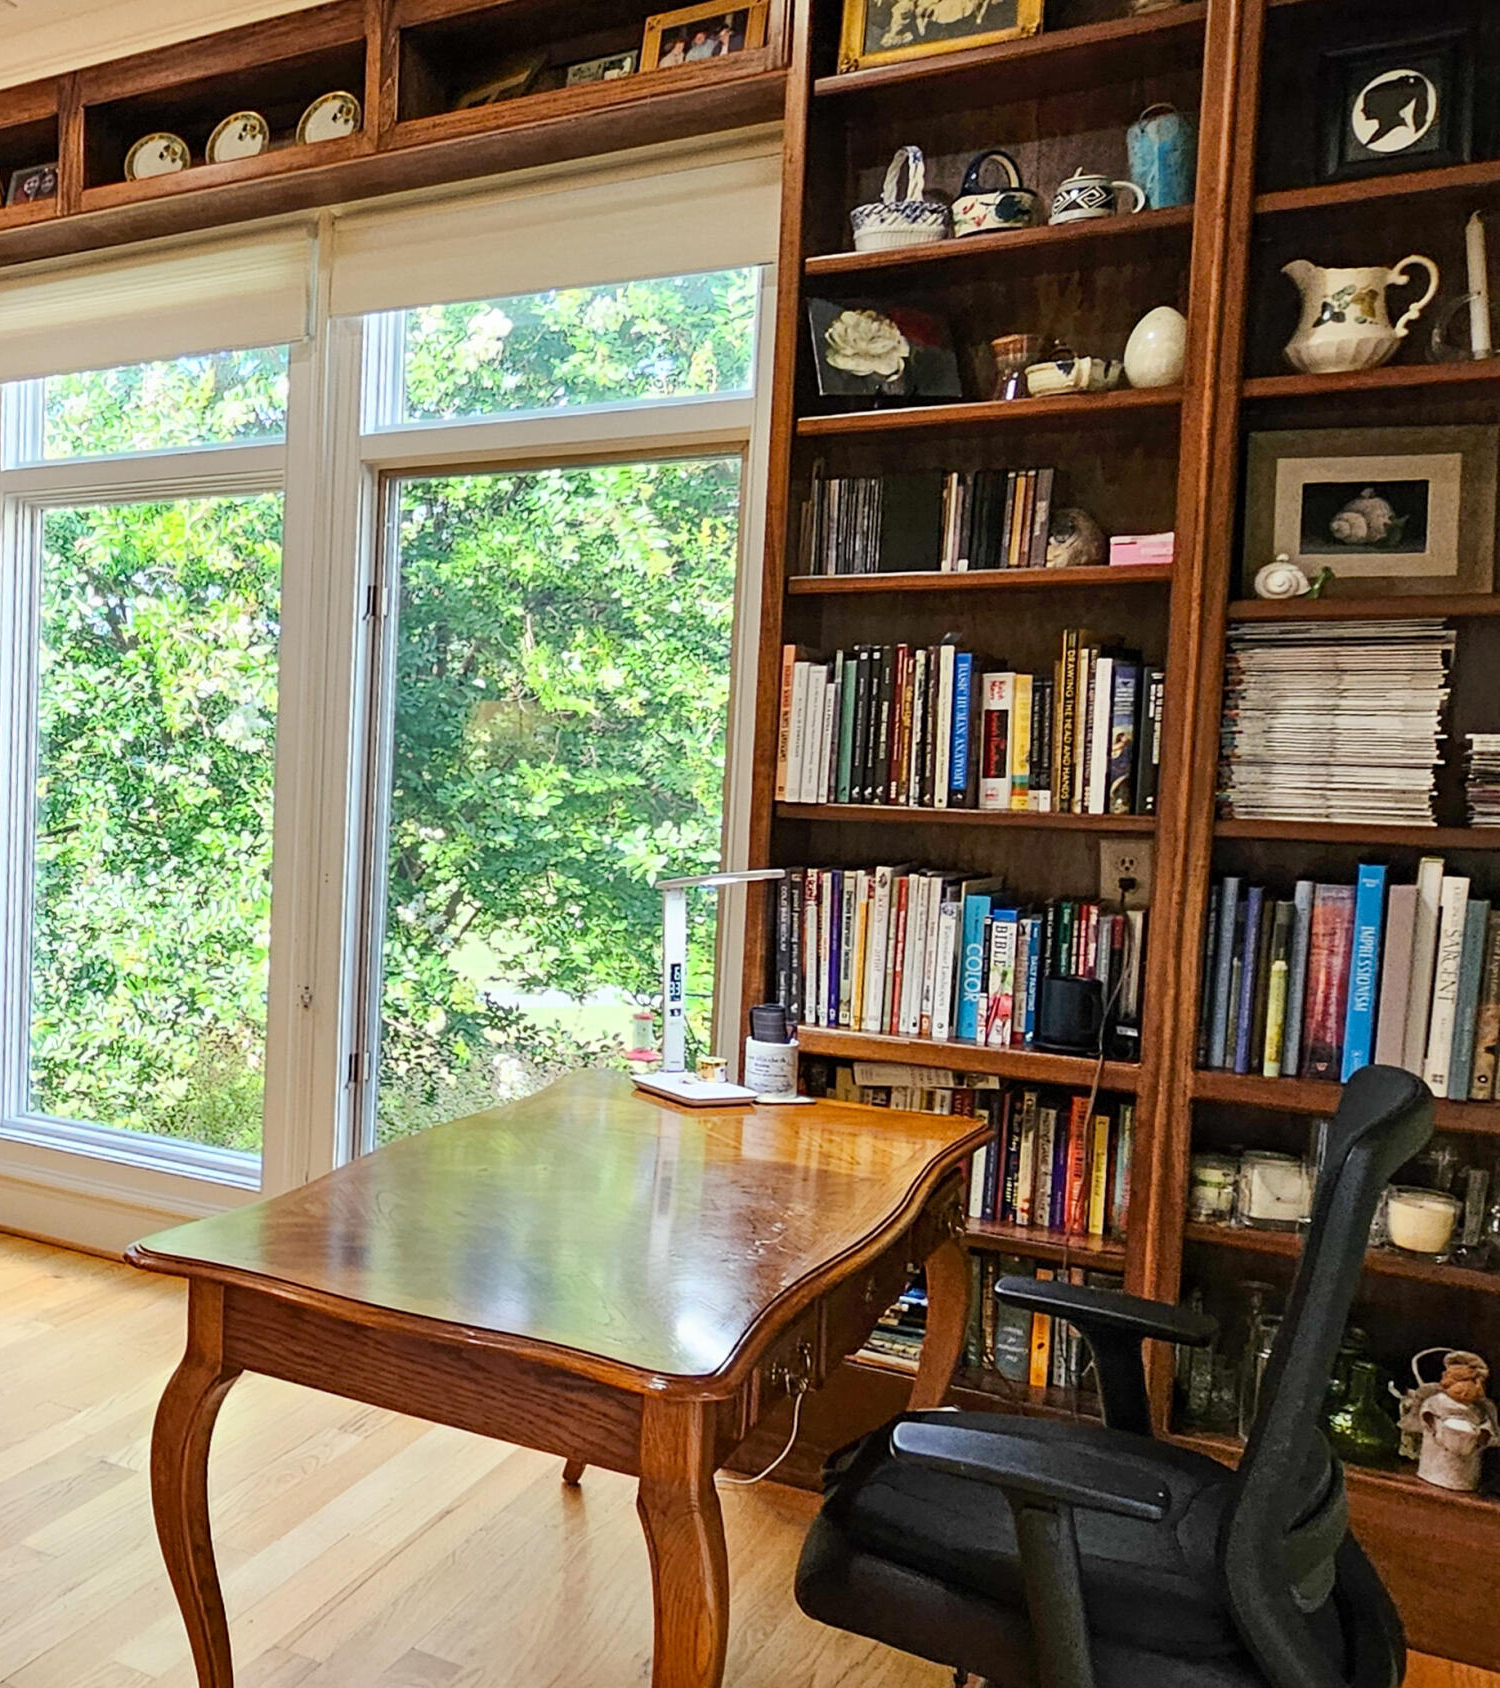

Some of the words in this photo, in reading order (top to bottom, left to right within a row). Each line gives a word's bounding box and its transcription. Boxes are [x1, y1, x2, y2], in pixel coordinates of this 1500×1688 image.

[957, 663, 970, 695] BASIC
[1065, 649, 1076, 697] DRAWING
[955, 696, 968, 735] HUMAN
[1064, 700, 1073, 716] THE
[1063, 718, 1072, 744] HEAD
[953, 737, 967, 787] ANATOMY
[1062, 745, 1071, 765] AND
[1060, 767, 1070, 799] HANDS
[994, 925, 1009, 968] BIBLE
[1437, 928, 1462, 1006] SARGENT
[964, 943, 983, 1002] COLOR
[1353, 926, 1376, 1012] IMPRESSIONISM
